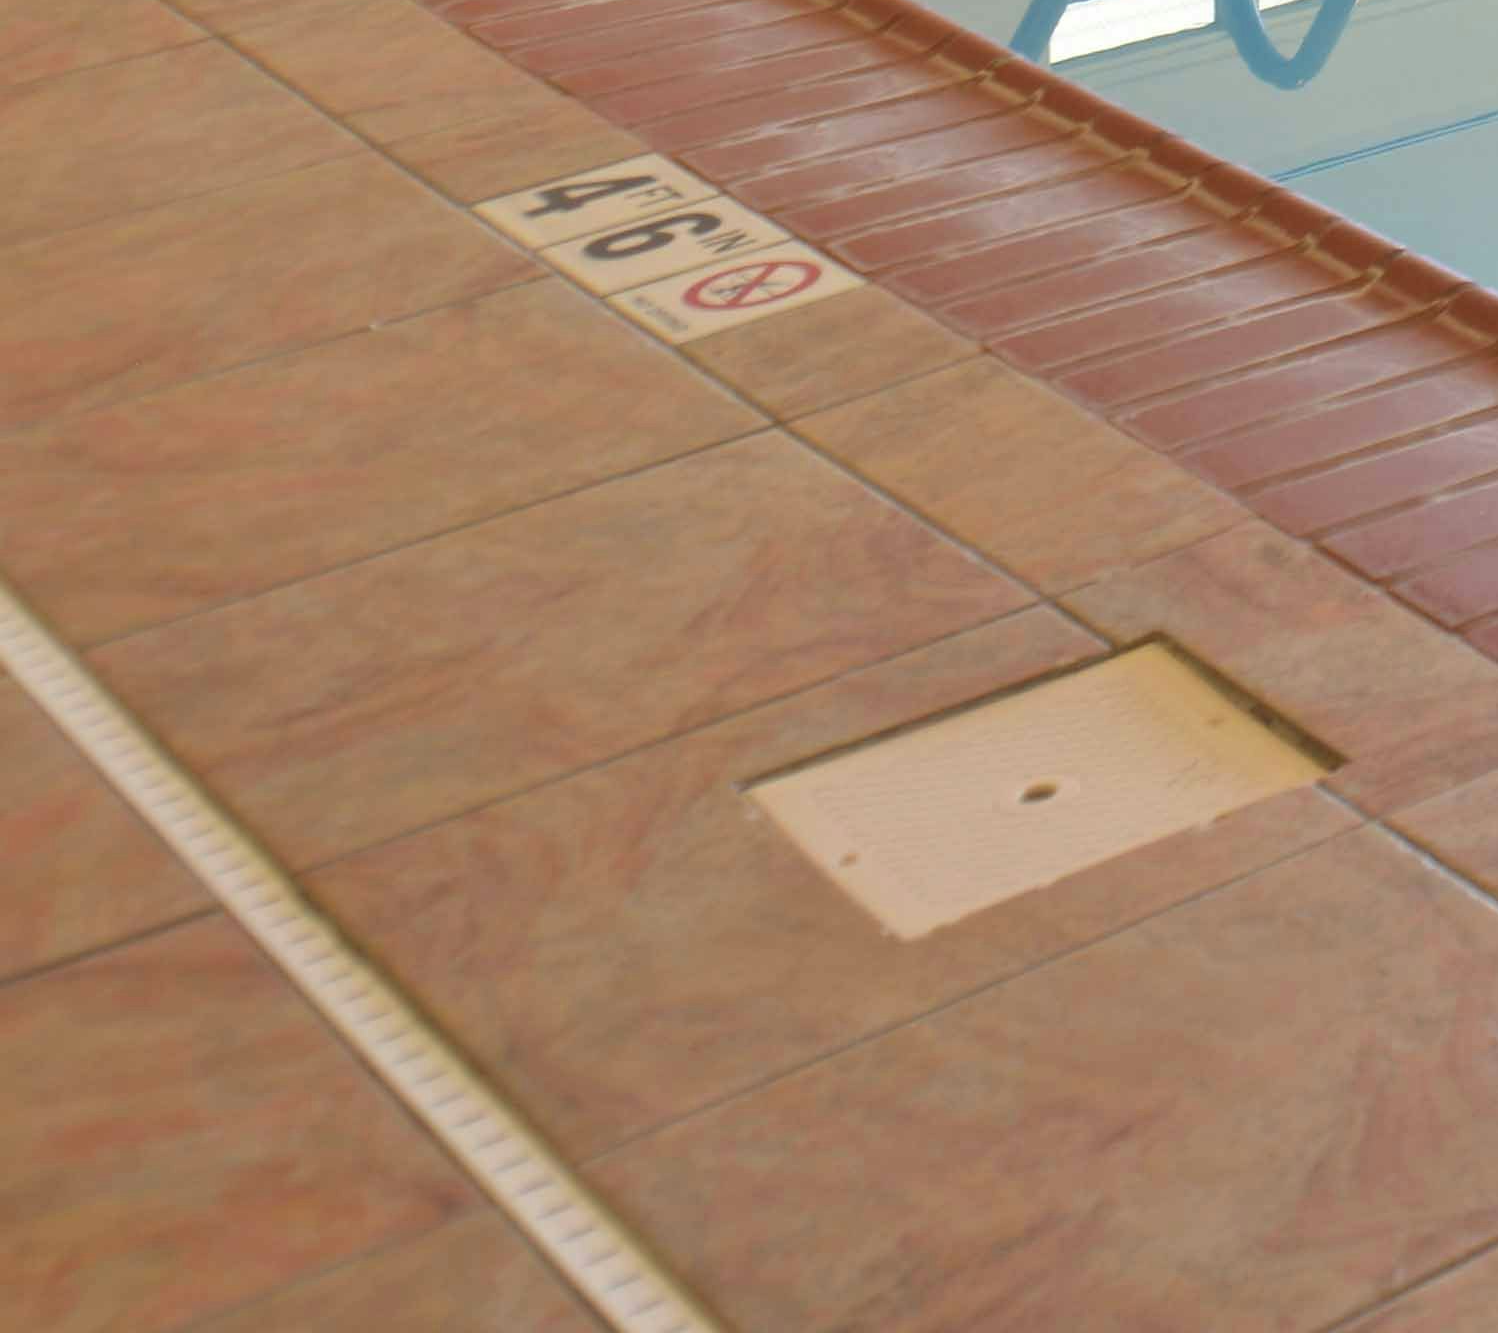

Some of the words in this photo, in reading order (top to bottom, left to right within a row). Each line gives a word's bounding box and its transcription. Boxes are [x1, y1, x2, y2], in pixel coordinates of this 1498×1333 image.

[522, 175, 660, 218] 4
[623, 186, 684, 208] FT
[582, 212, 722, 261] 6
[696, 229, 758, 254] IN
